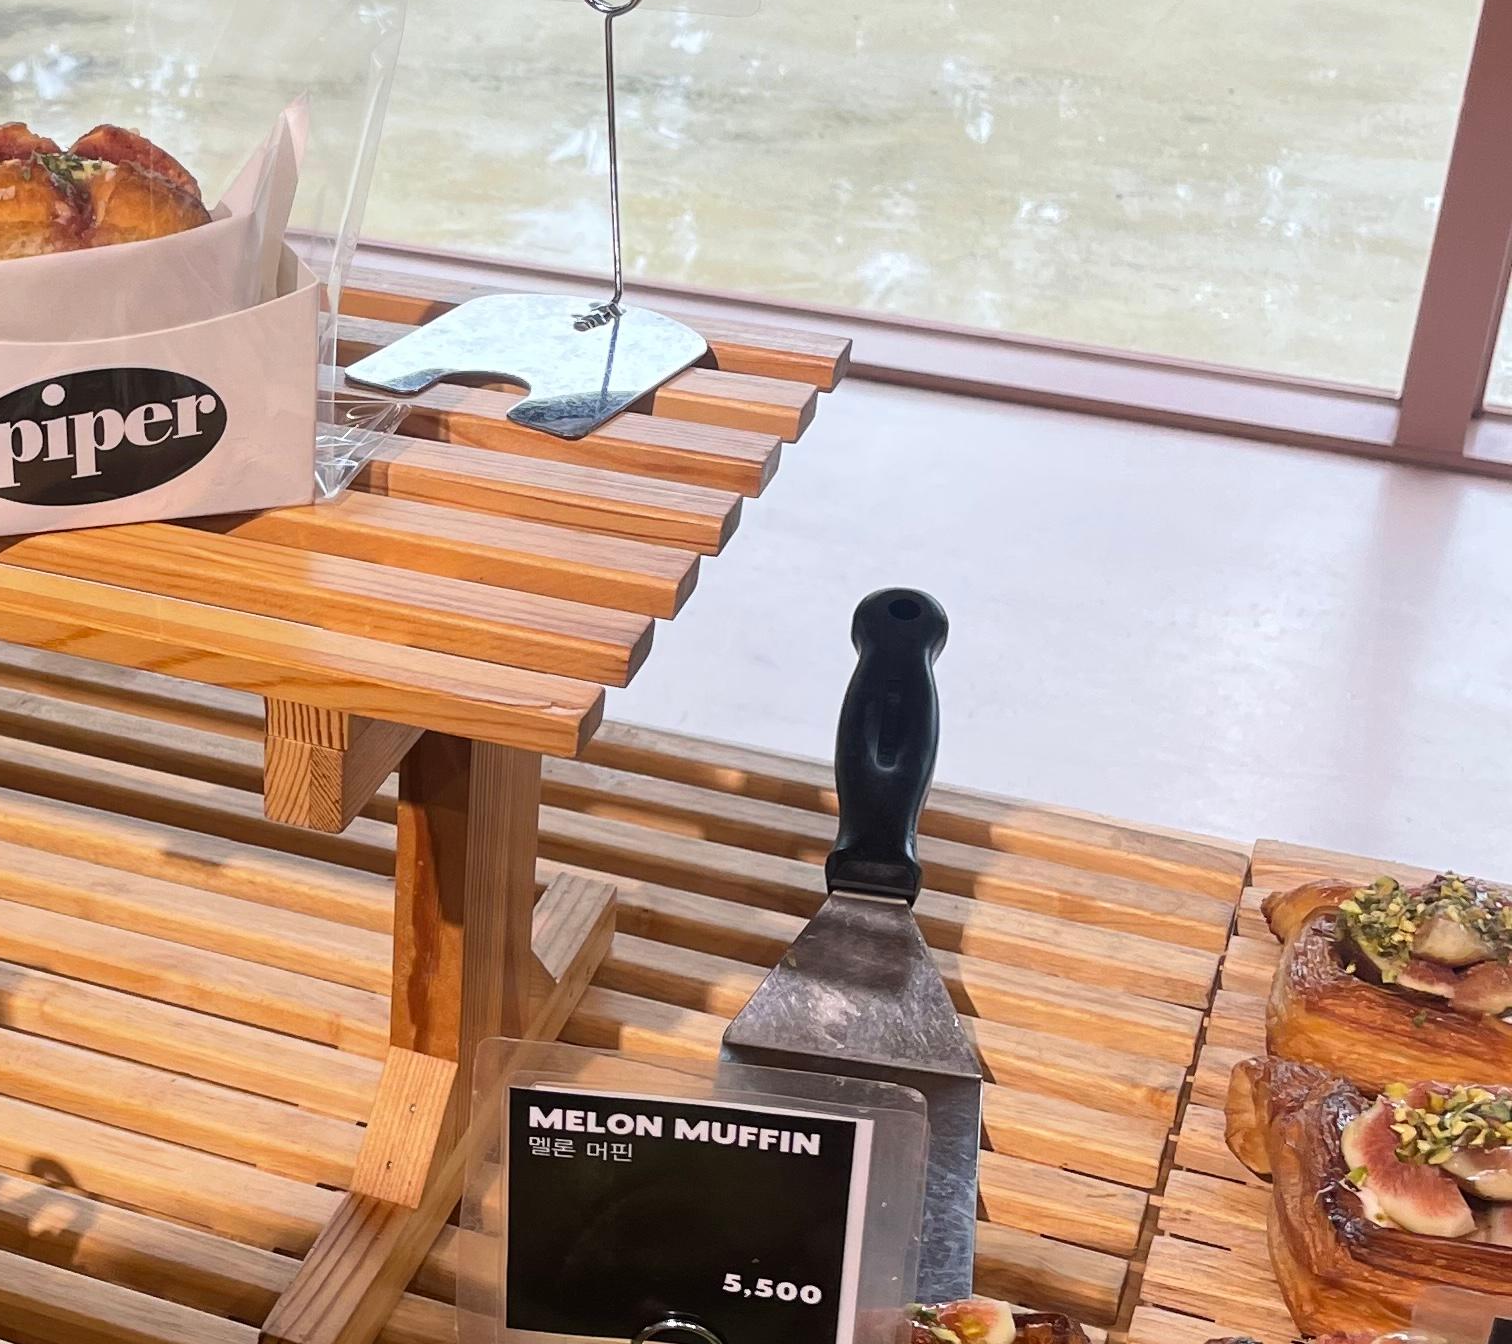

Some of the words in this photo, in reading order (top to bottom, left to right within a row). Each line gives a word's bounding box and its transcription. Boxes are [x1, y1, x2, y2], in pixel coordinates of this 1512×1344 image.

[529, 1106, 663, 1137] MELON
[674, 1118, 821, 1155] MUFFIN
[529, 1136, 576, 1158] 멜론
[587, 1142, 633, 1163] 머핀
[723, 1273, 822, 1305] 5,500
